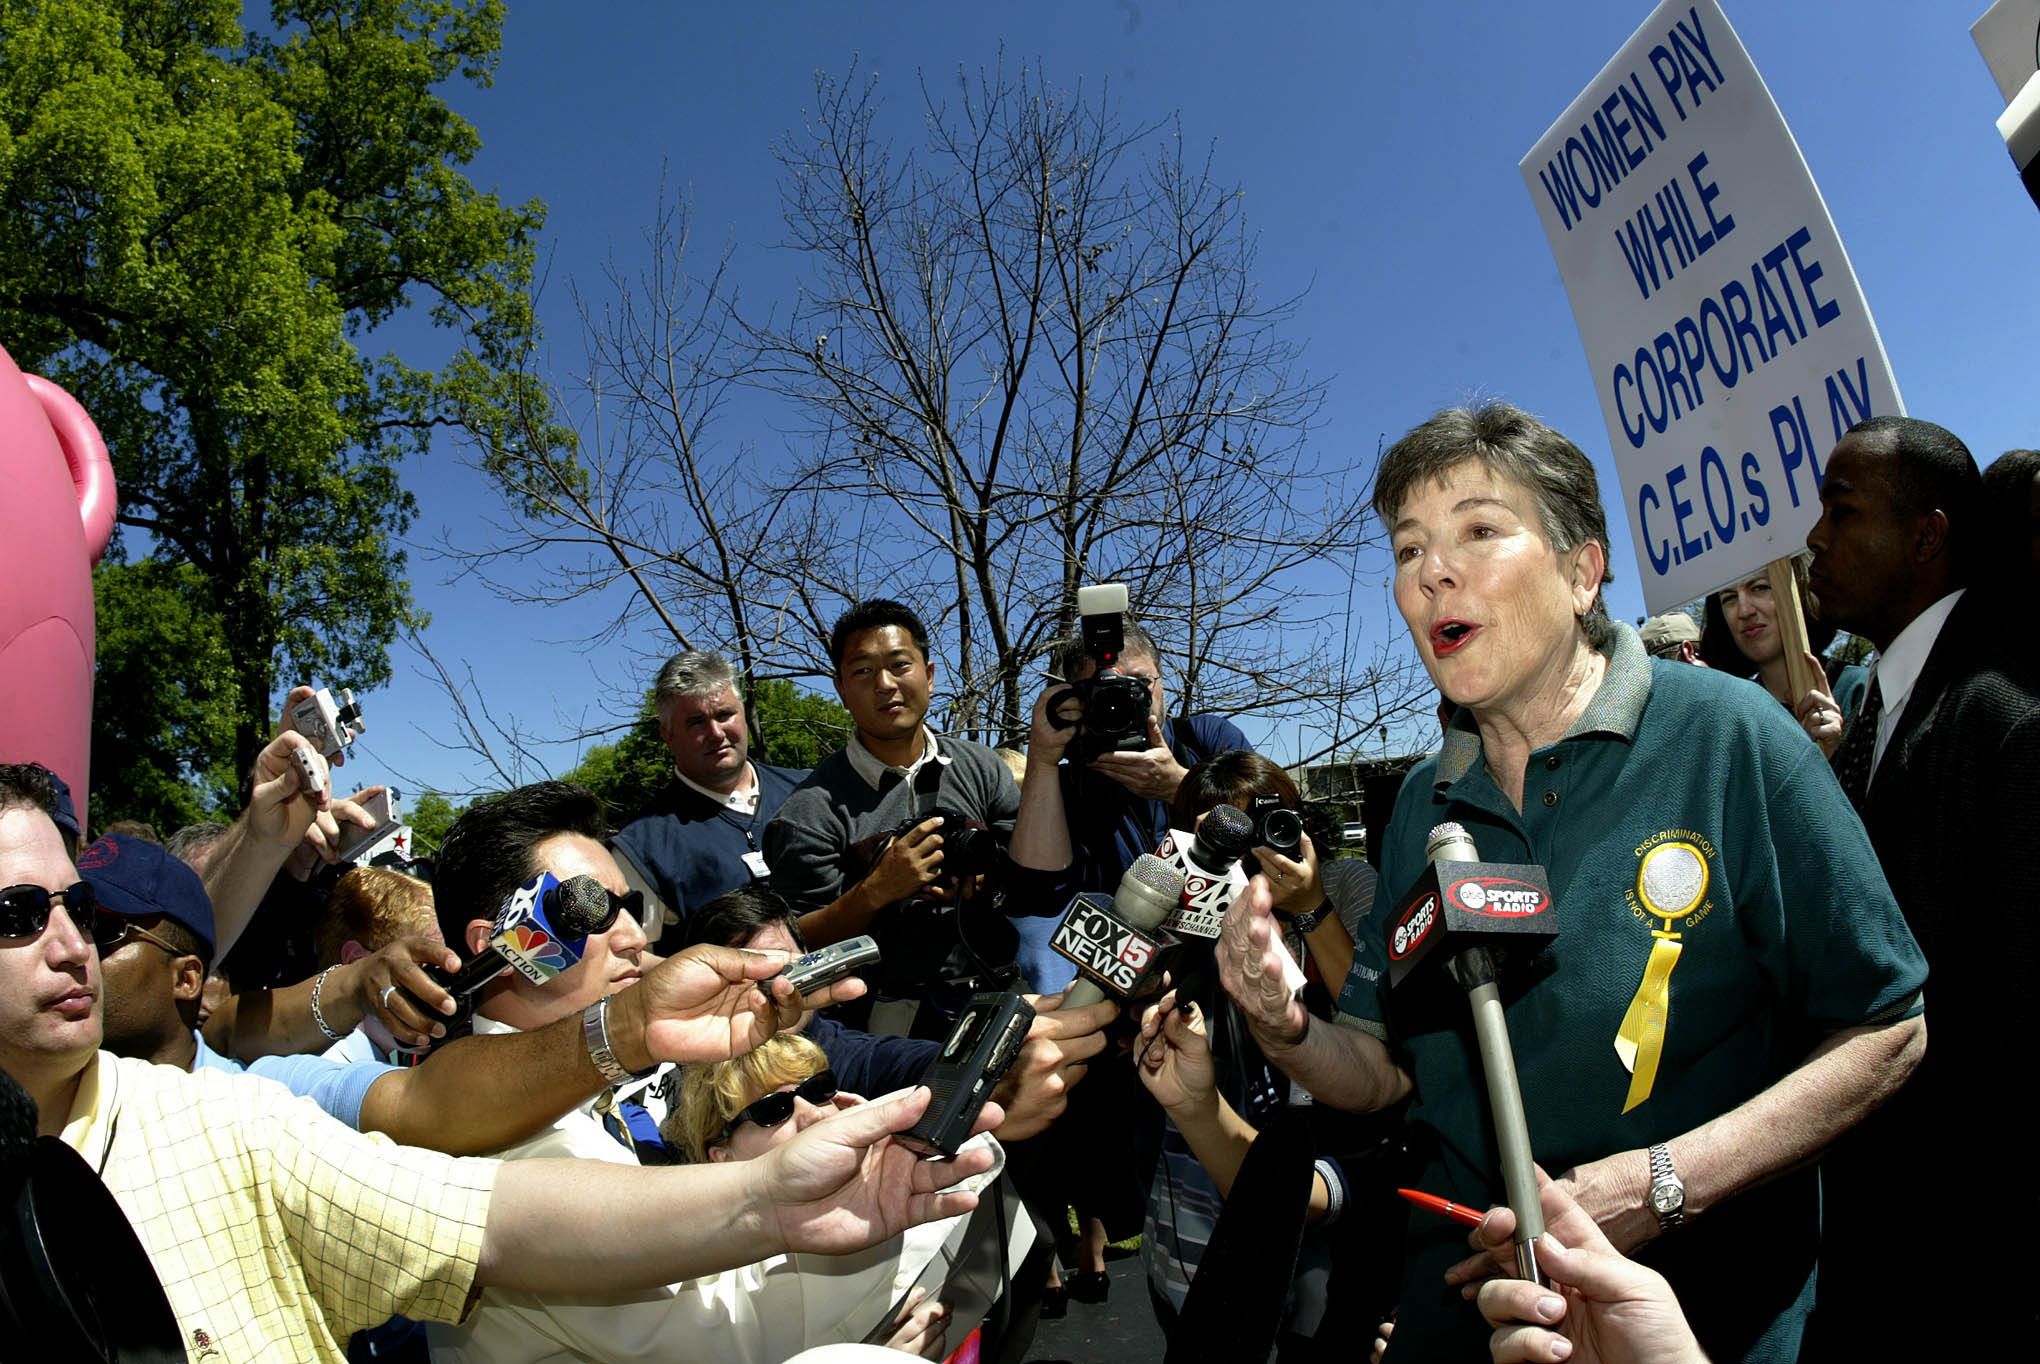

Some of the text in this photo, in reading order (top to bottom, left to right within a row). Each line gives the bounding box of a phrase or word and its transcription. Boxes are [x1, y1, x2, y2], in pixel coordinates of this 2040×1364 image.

[1539, 7, 1725, 231] WOMEN PAY
[1614, 151, 1736, 300] WHILE
[1613, 226, 1841, 449] CORPORATE
[1639, 357, 1873, 576] C.E.O.s PLAY
[1634, 829, 1716, 859] DISCRIMINATION
[1485, 889, 1539, 904] SPORTS
[1493, 902, 1536, 913] RADIO
[1624, 888, 1714, 928] IS NOT A GAME
[1066, 901, 1153, 969] FOX 5
[1170, 909, 1222, 928] TLANTA'S
[1407, 897, 1435, 937] SPORTS
[1410, 913, 1433, 944] RADIO
[496, 943, 543, 981] ACTION
[1054, 926, 1136, 989] NEWS
